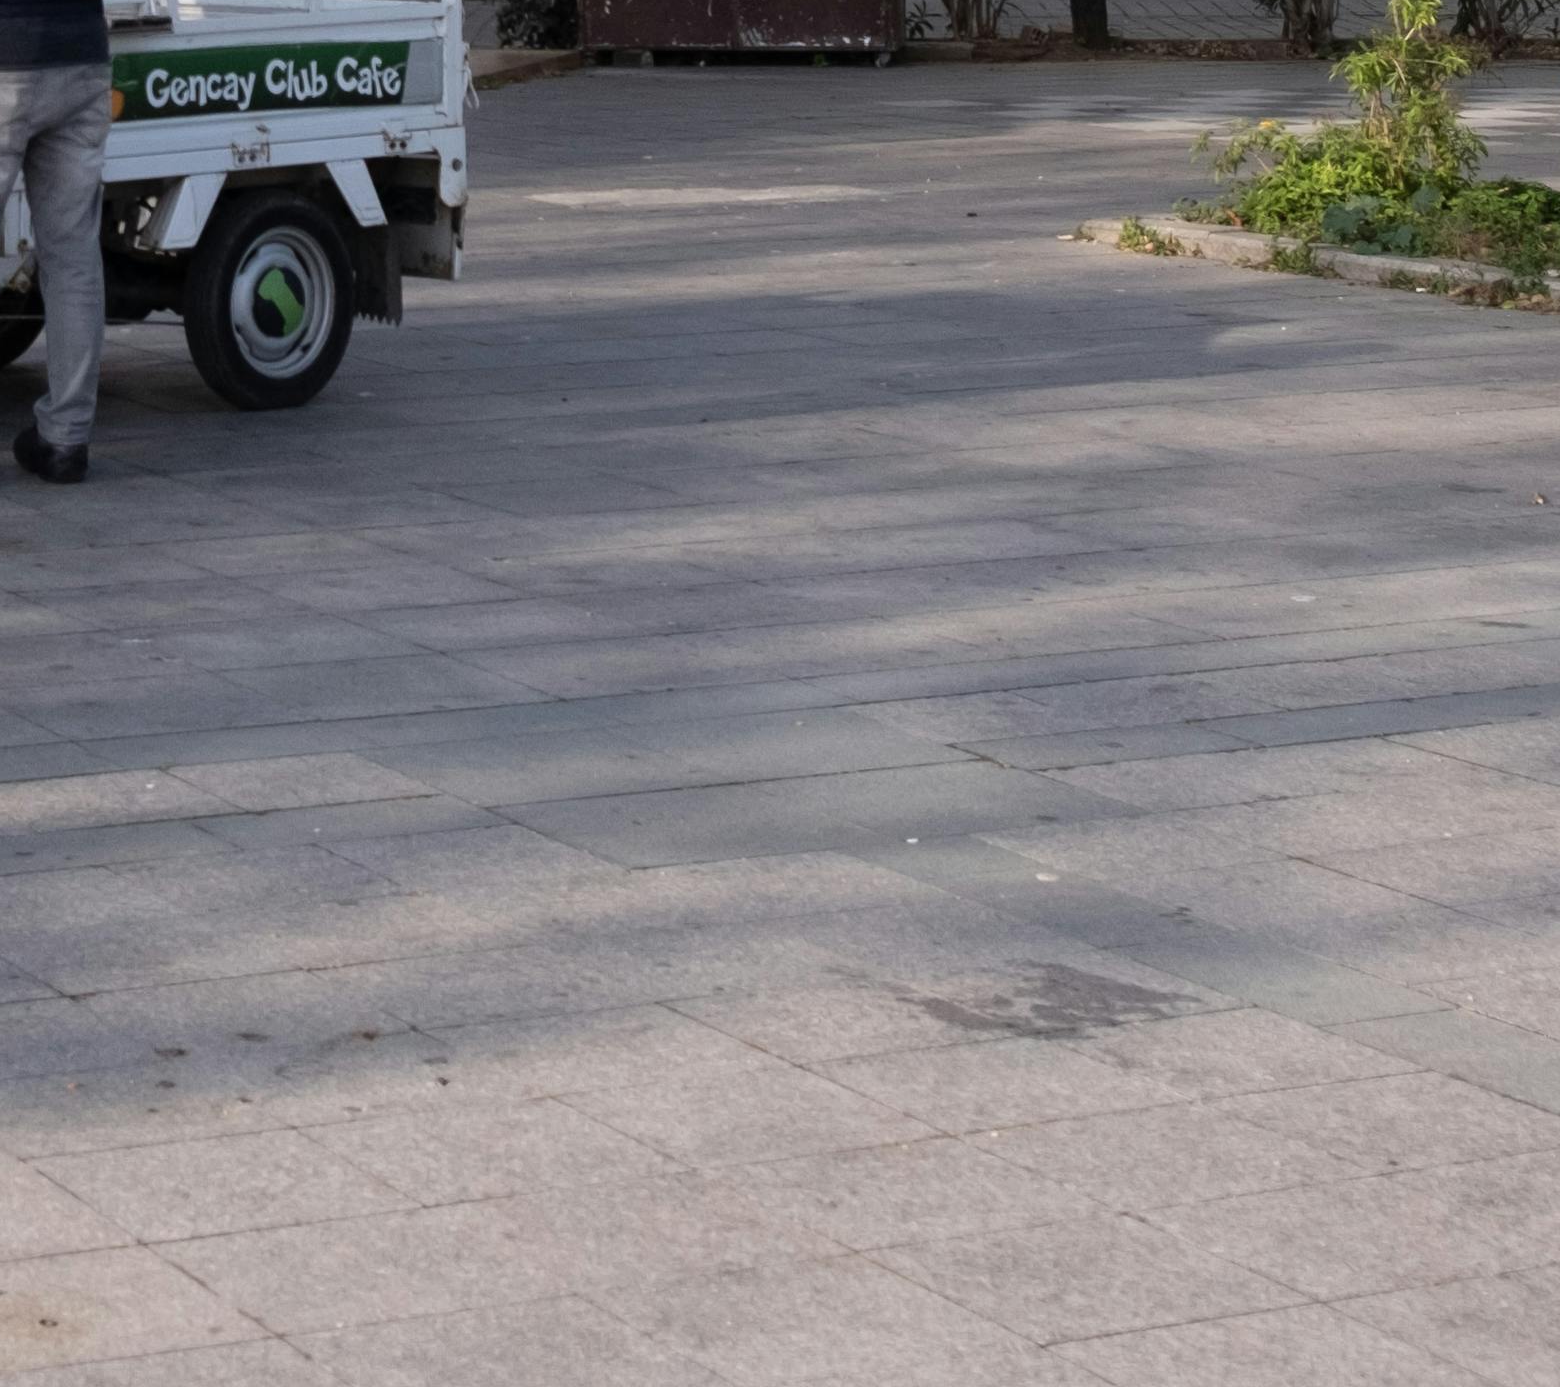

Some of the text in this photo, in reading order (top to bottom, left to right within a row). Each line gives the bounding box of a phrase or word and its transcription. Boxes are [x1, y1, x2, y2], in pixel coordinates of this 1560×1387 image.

[145, 55, 402, 111] Gencay Club Cafe
